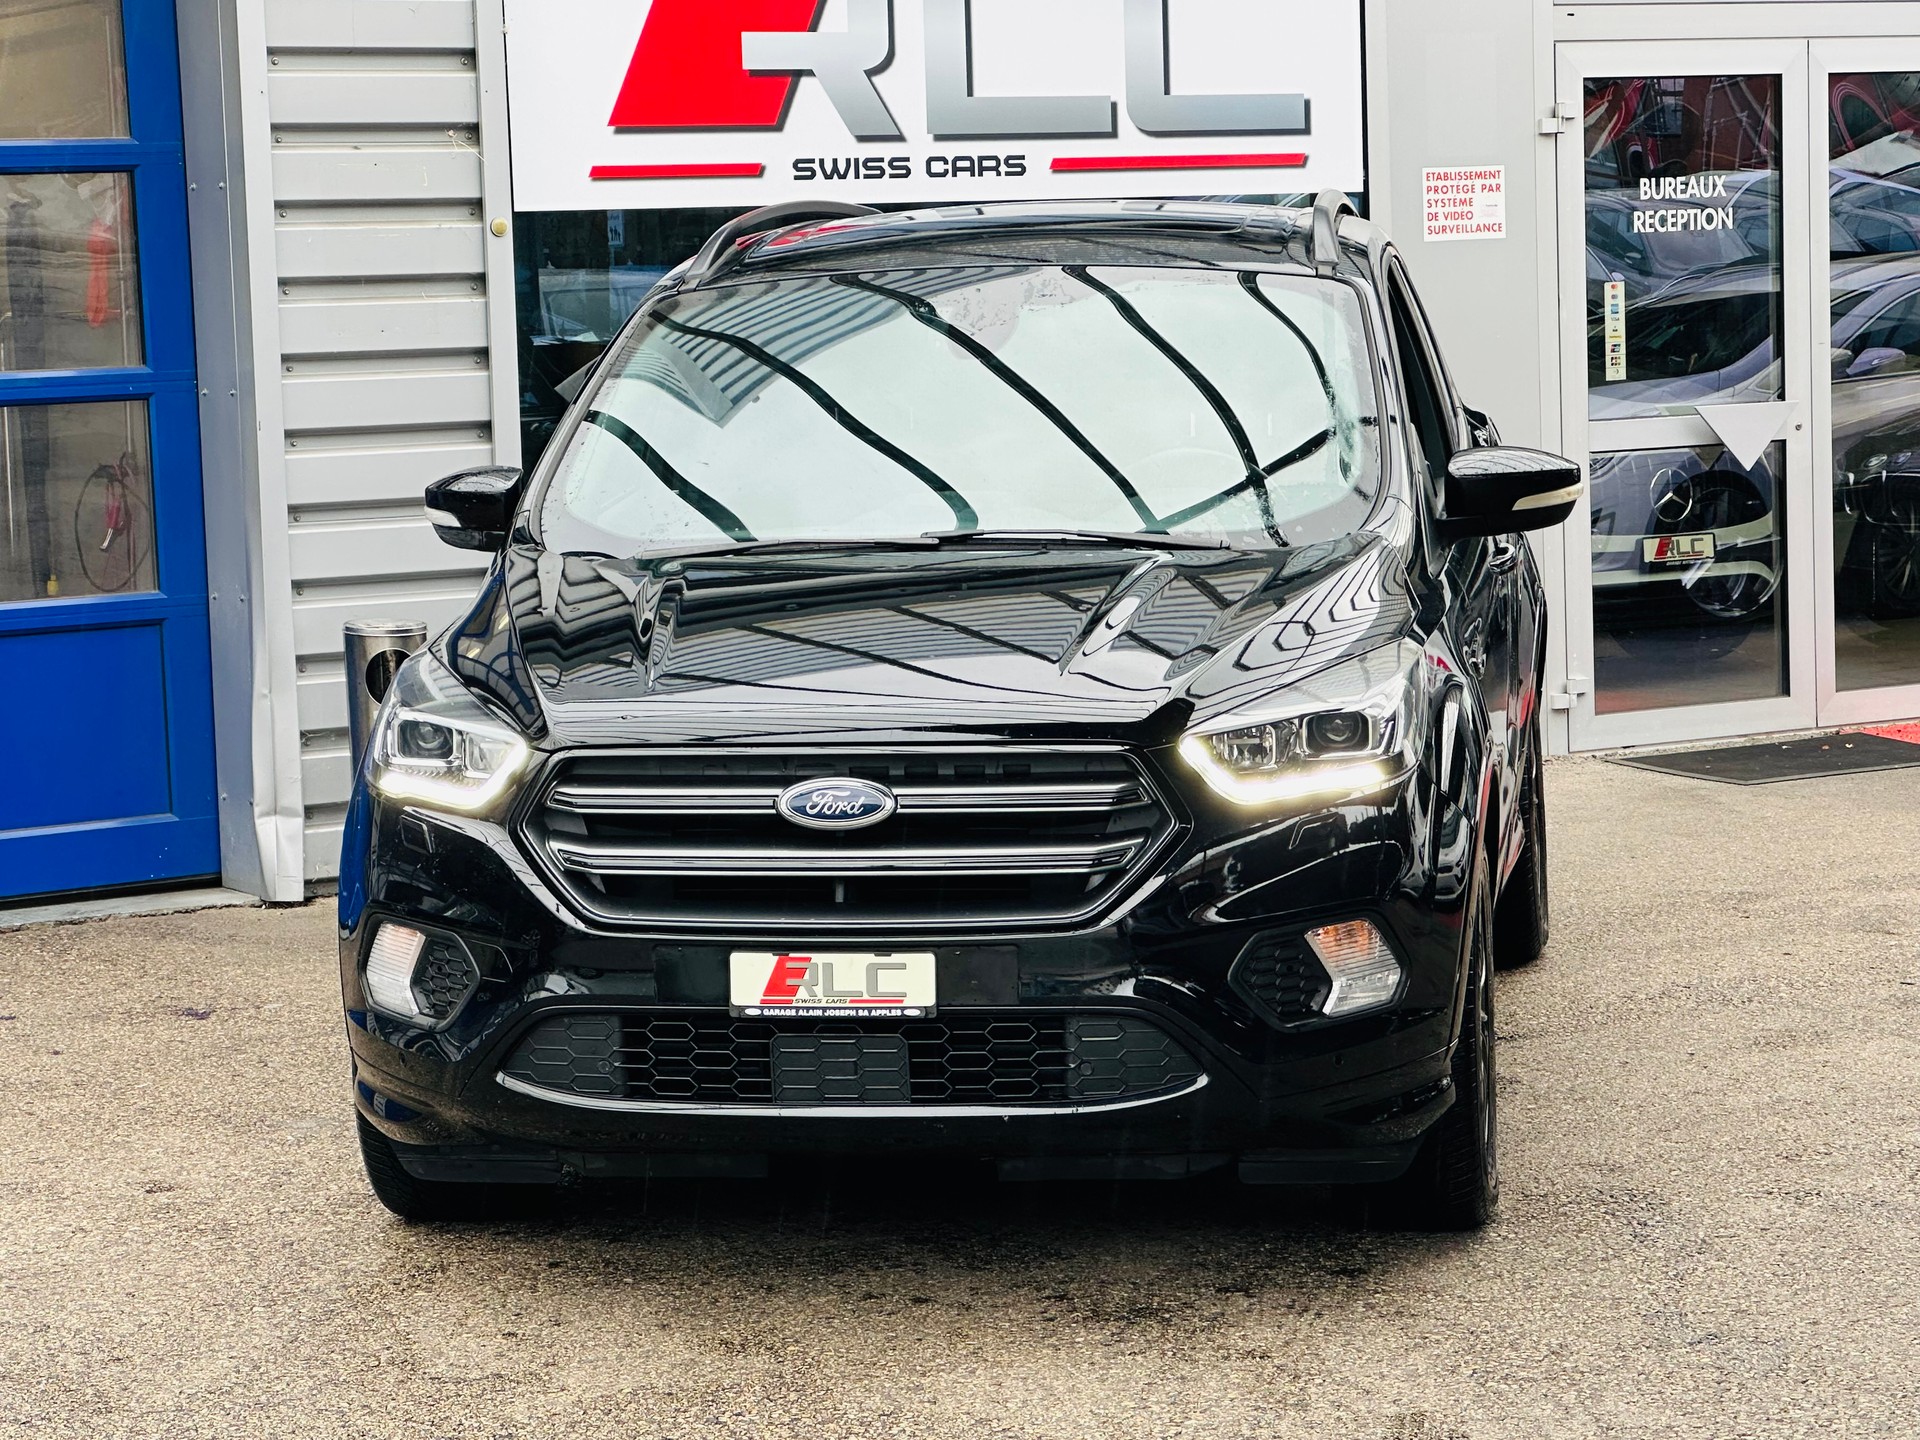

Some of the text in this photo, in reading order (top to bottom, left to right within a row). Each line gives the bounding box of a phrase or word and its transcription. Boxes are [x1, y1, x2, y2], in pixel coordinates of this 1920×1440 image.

[792, 155, 1027, 181] SWISS CARS
[1426, 170, 1502, 182] ETABLISSEMENT
[1481, 183, 1502, 193] PAR
[1639, 175, 1727, 200] BUREAUX
[1427, 212, 1439, 221] DE
[1633, 207, 1734, 233] RECEPTION
[1427, 223, 1503, 235] SURVEILLANCE
[805, 789, 865, 815] Ford
[762, 1008, 902, 1017] GARAGE ALAIN JOSEPH SA APPLES
